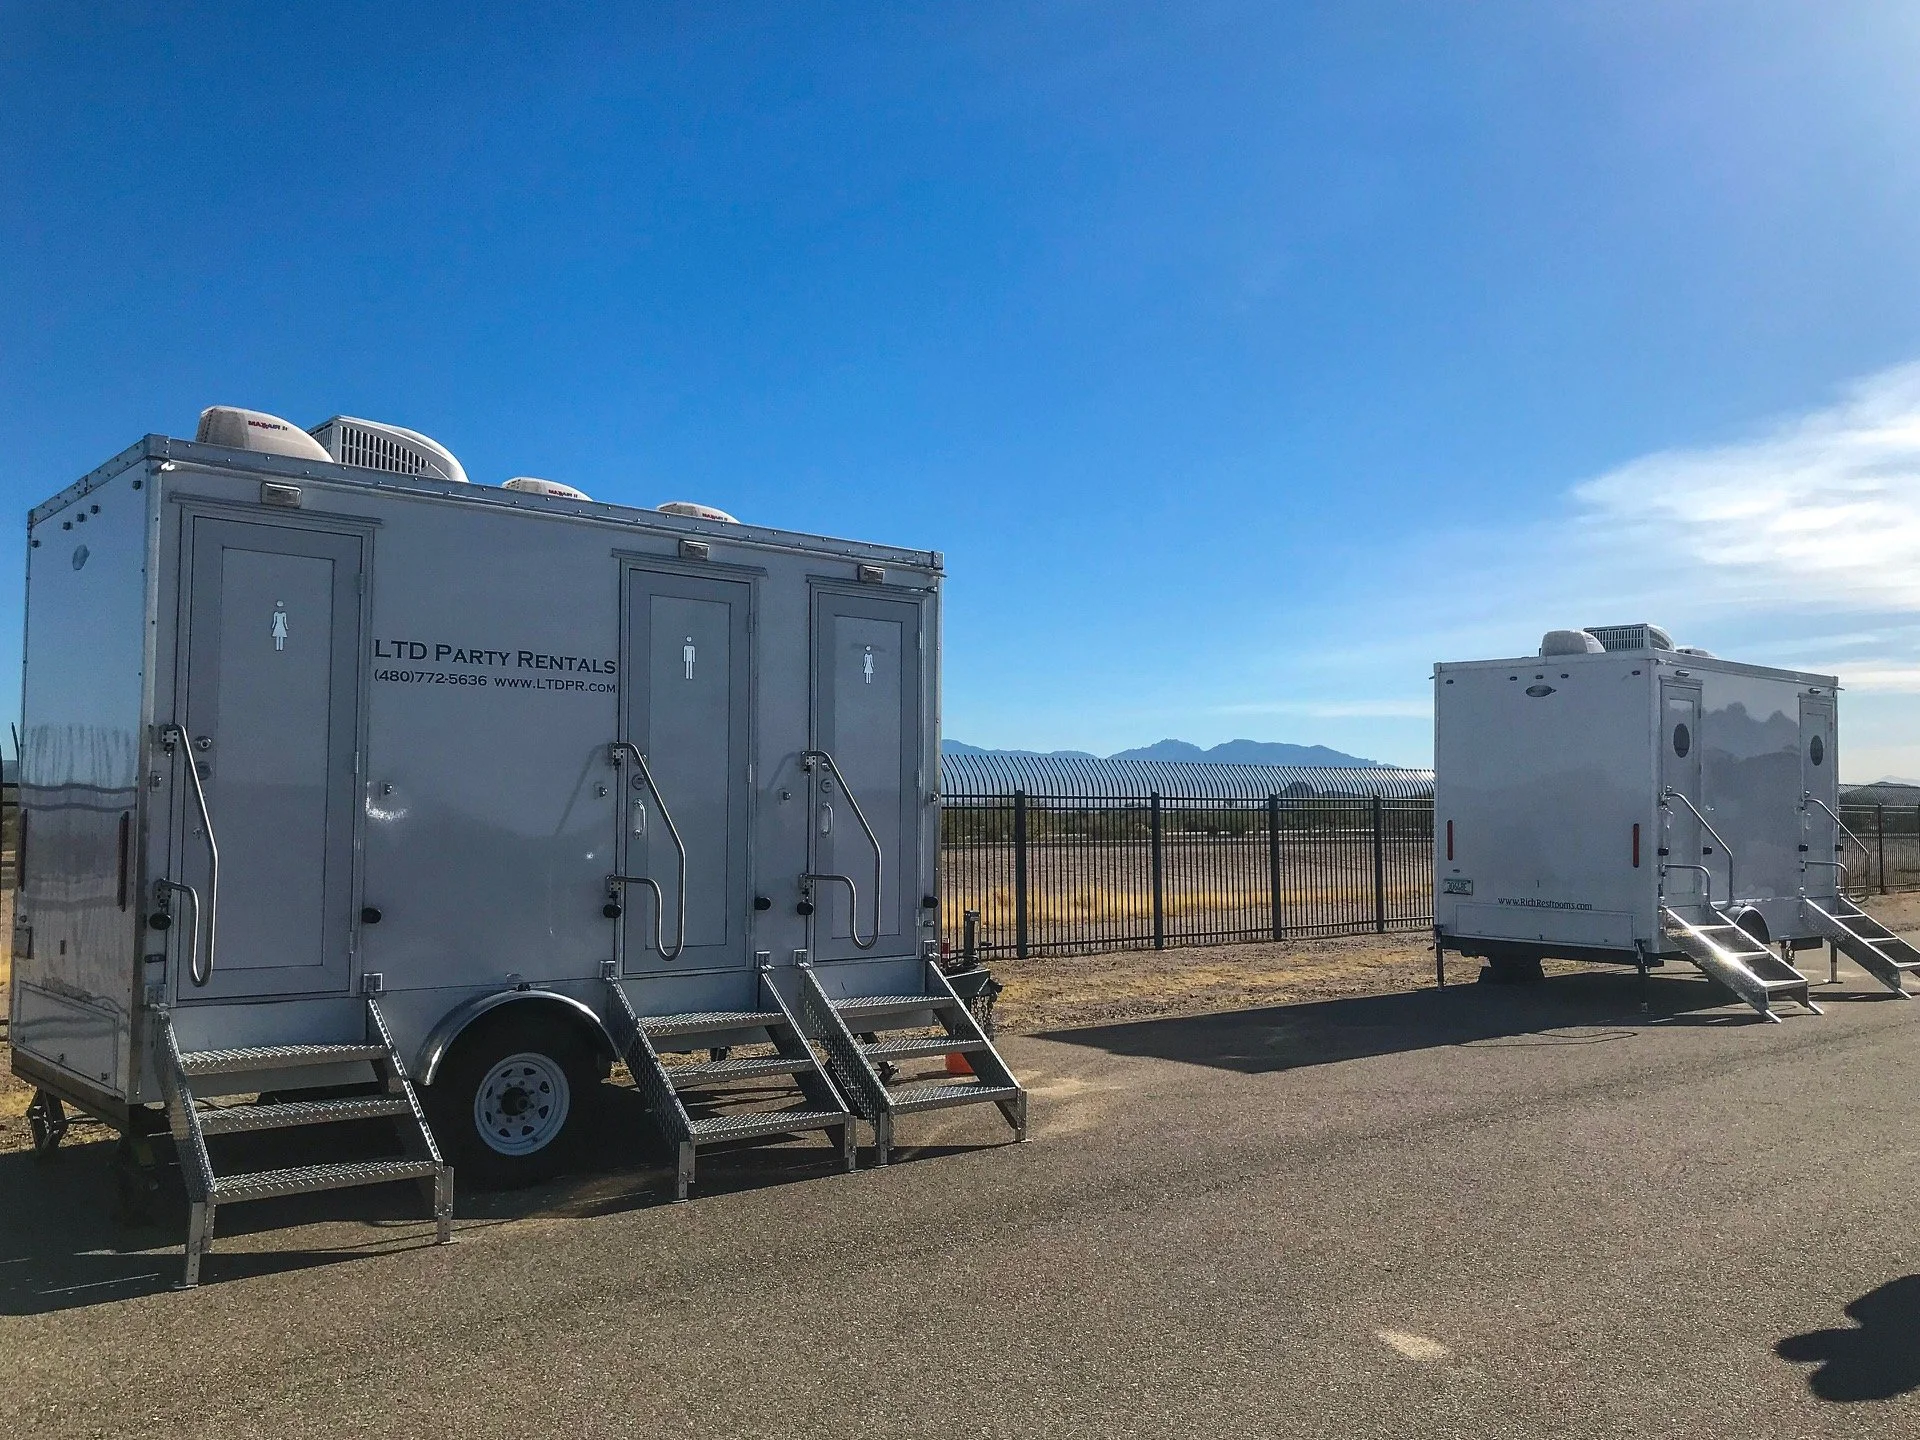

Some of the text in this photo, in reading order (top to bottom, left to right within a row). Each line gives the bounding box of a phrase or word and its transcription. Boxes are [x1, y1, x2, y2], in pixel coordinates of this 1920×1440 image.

[374, 639, 617, 674] LTD PARTY RENTALS
[374, 669, 488, 686] (480)772-5636
[1498, 897, 1593, 911] www.RichRestrooms.com
